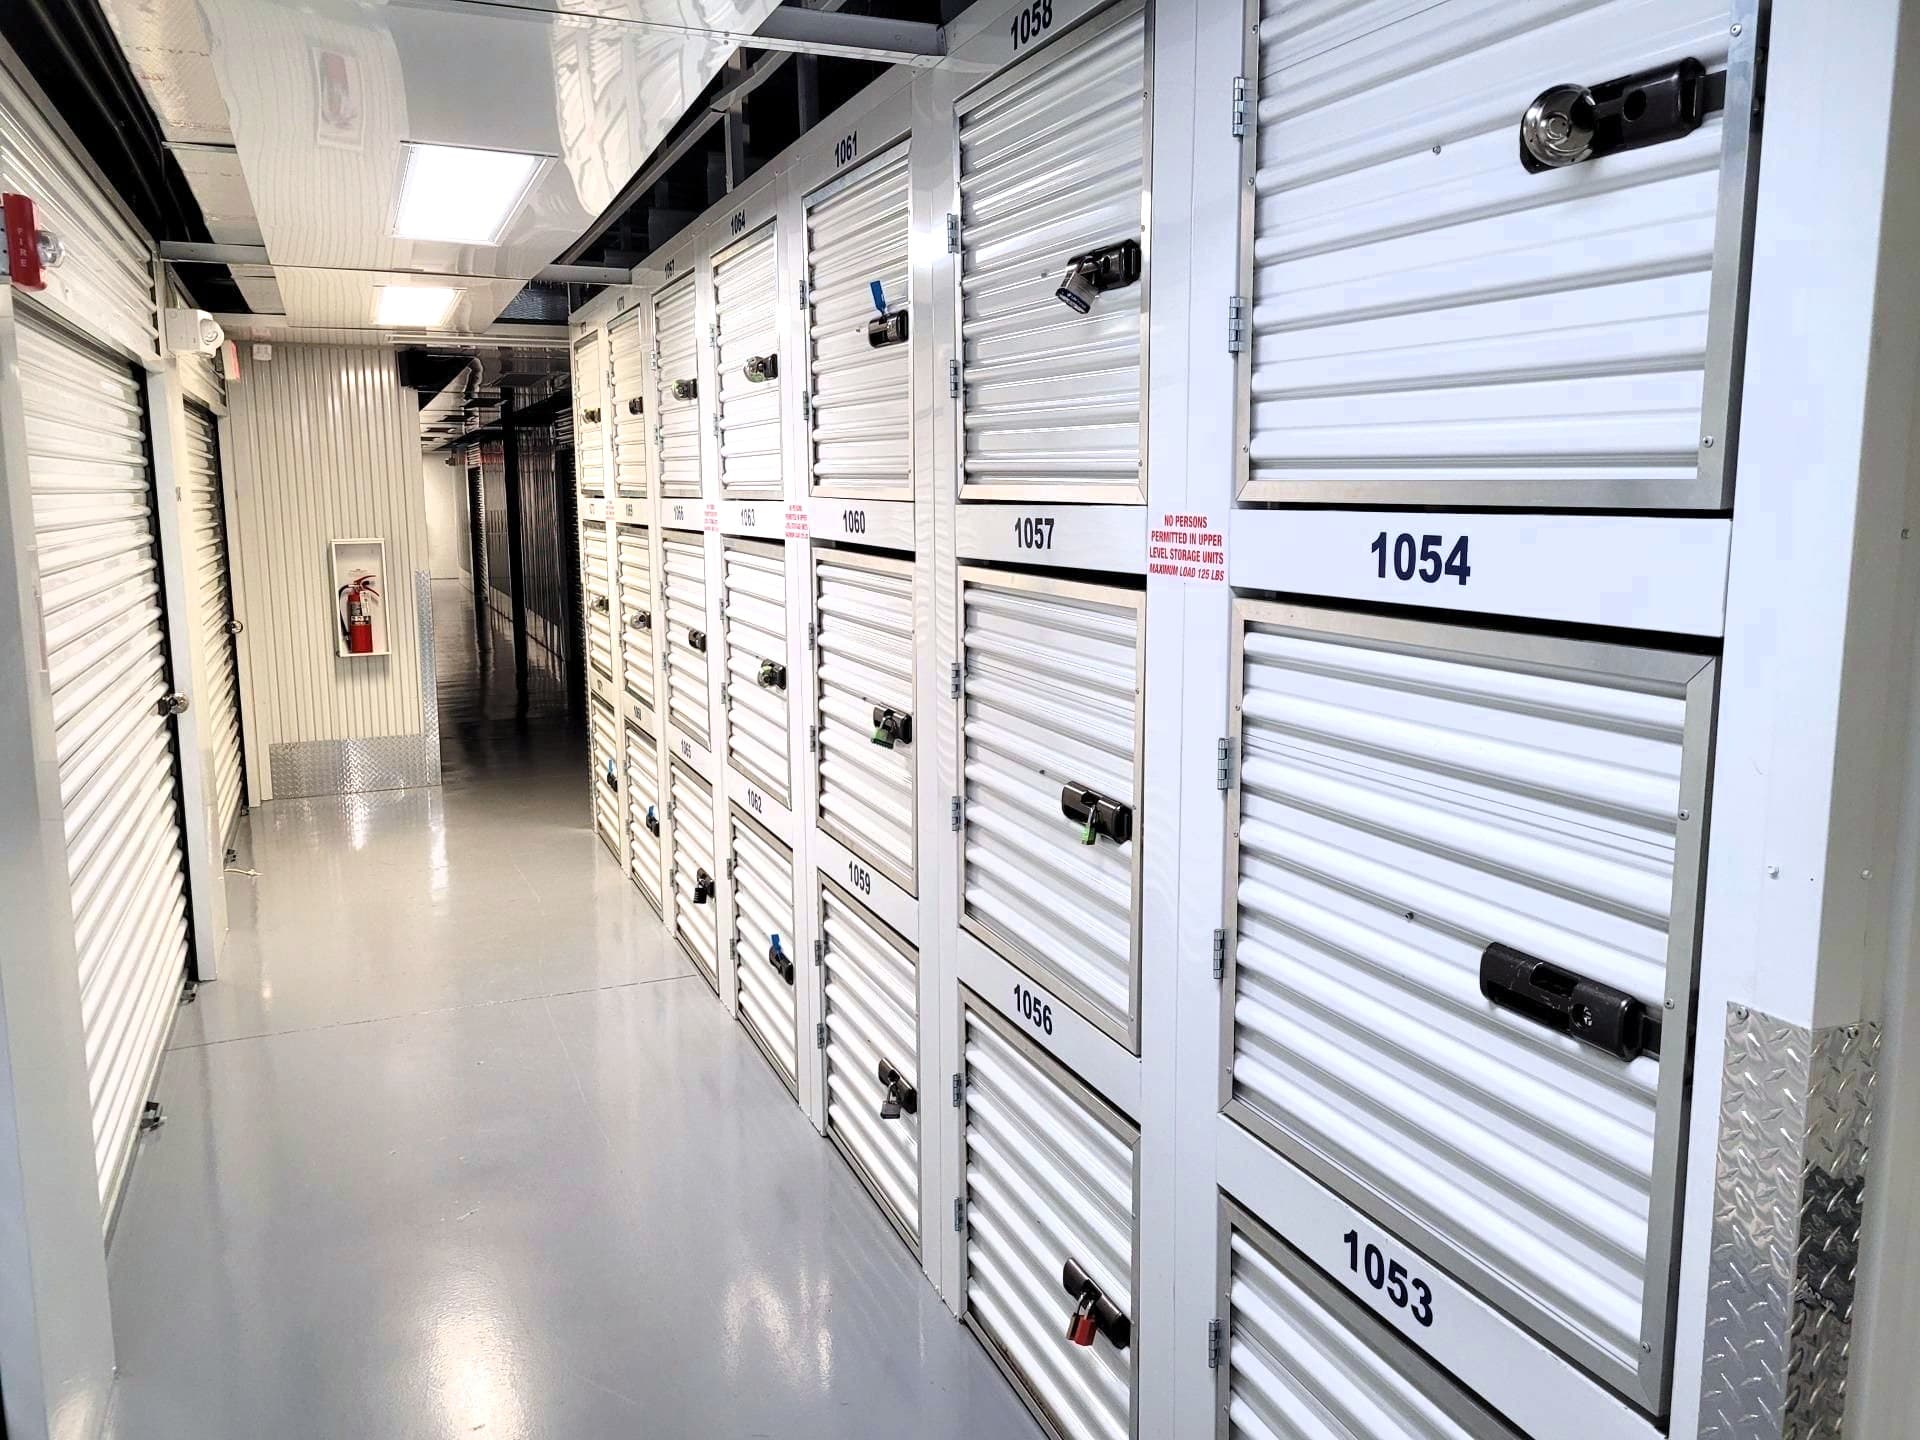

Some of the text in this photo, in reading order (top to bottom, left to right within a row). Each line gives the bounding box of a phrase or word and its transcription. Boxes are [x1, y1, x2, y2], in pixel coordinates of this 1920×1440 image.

[1011, 0, 1053, 50] 1058
[835, 131, 857, 168] 1061
[731, 209, 746, 237] 1064
[17, 227, 28, 267] FIRE
[741, 508, 755, 527] 1063
[843, 510, 866, 534] 1060
[1164, 514, 1208, 529] NO PERSONS
[1014, 517, 1055, 550] 1057
[1151, 530, 1222, 547] PERMITTED IN UPPER
[1149, 546, 1224, 565] LEVEL STORAGE UNITS
[1371, 531, 1471, 585] 1054
[1149, 563, 1224, 582] MAXIMUM LOAD 125 LBS
[748, 788, 762, 815] 1062
[848, 861, 871, 896] 1059
[1014, 984, 1053, 1036] 1056
[1343, 1229, 1434, 1328] 1053
